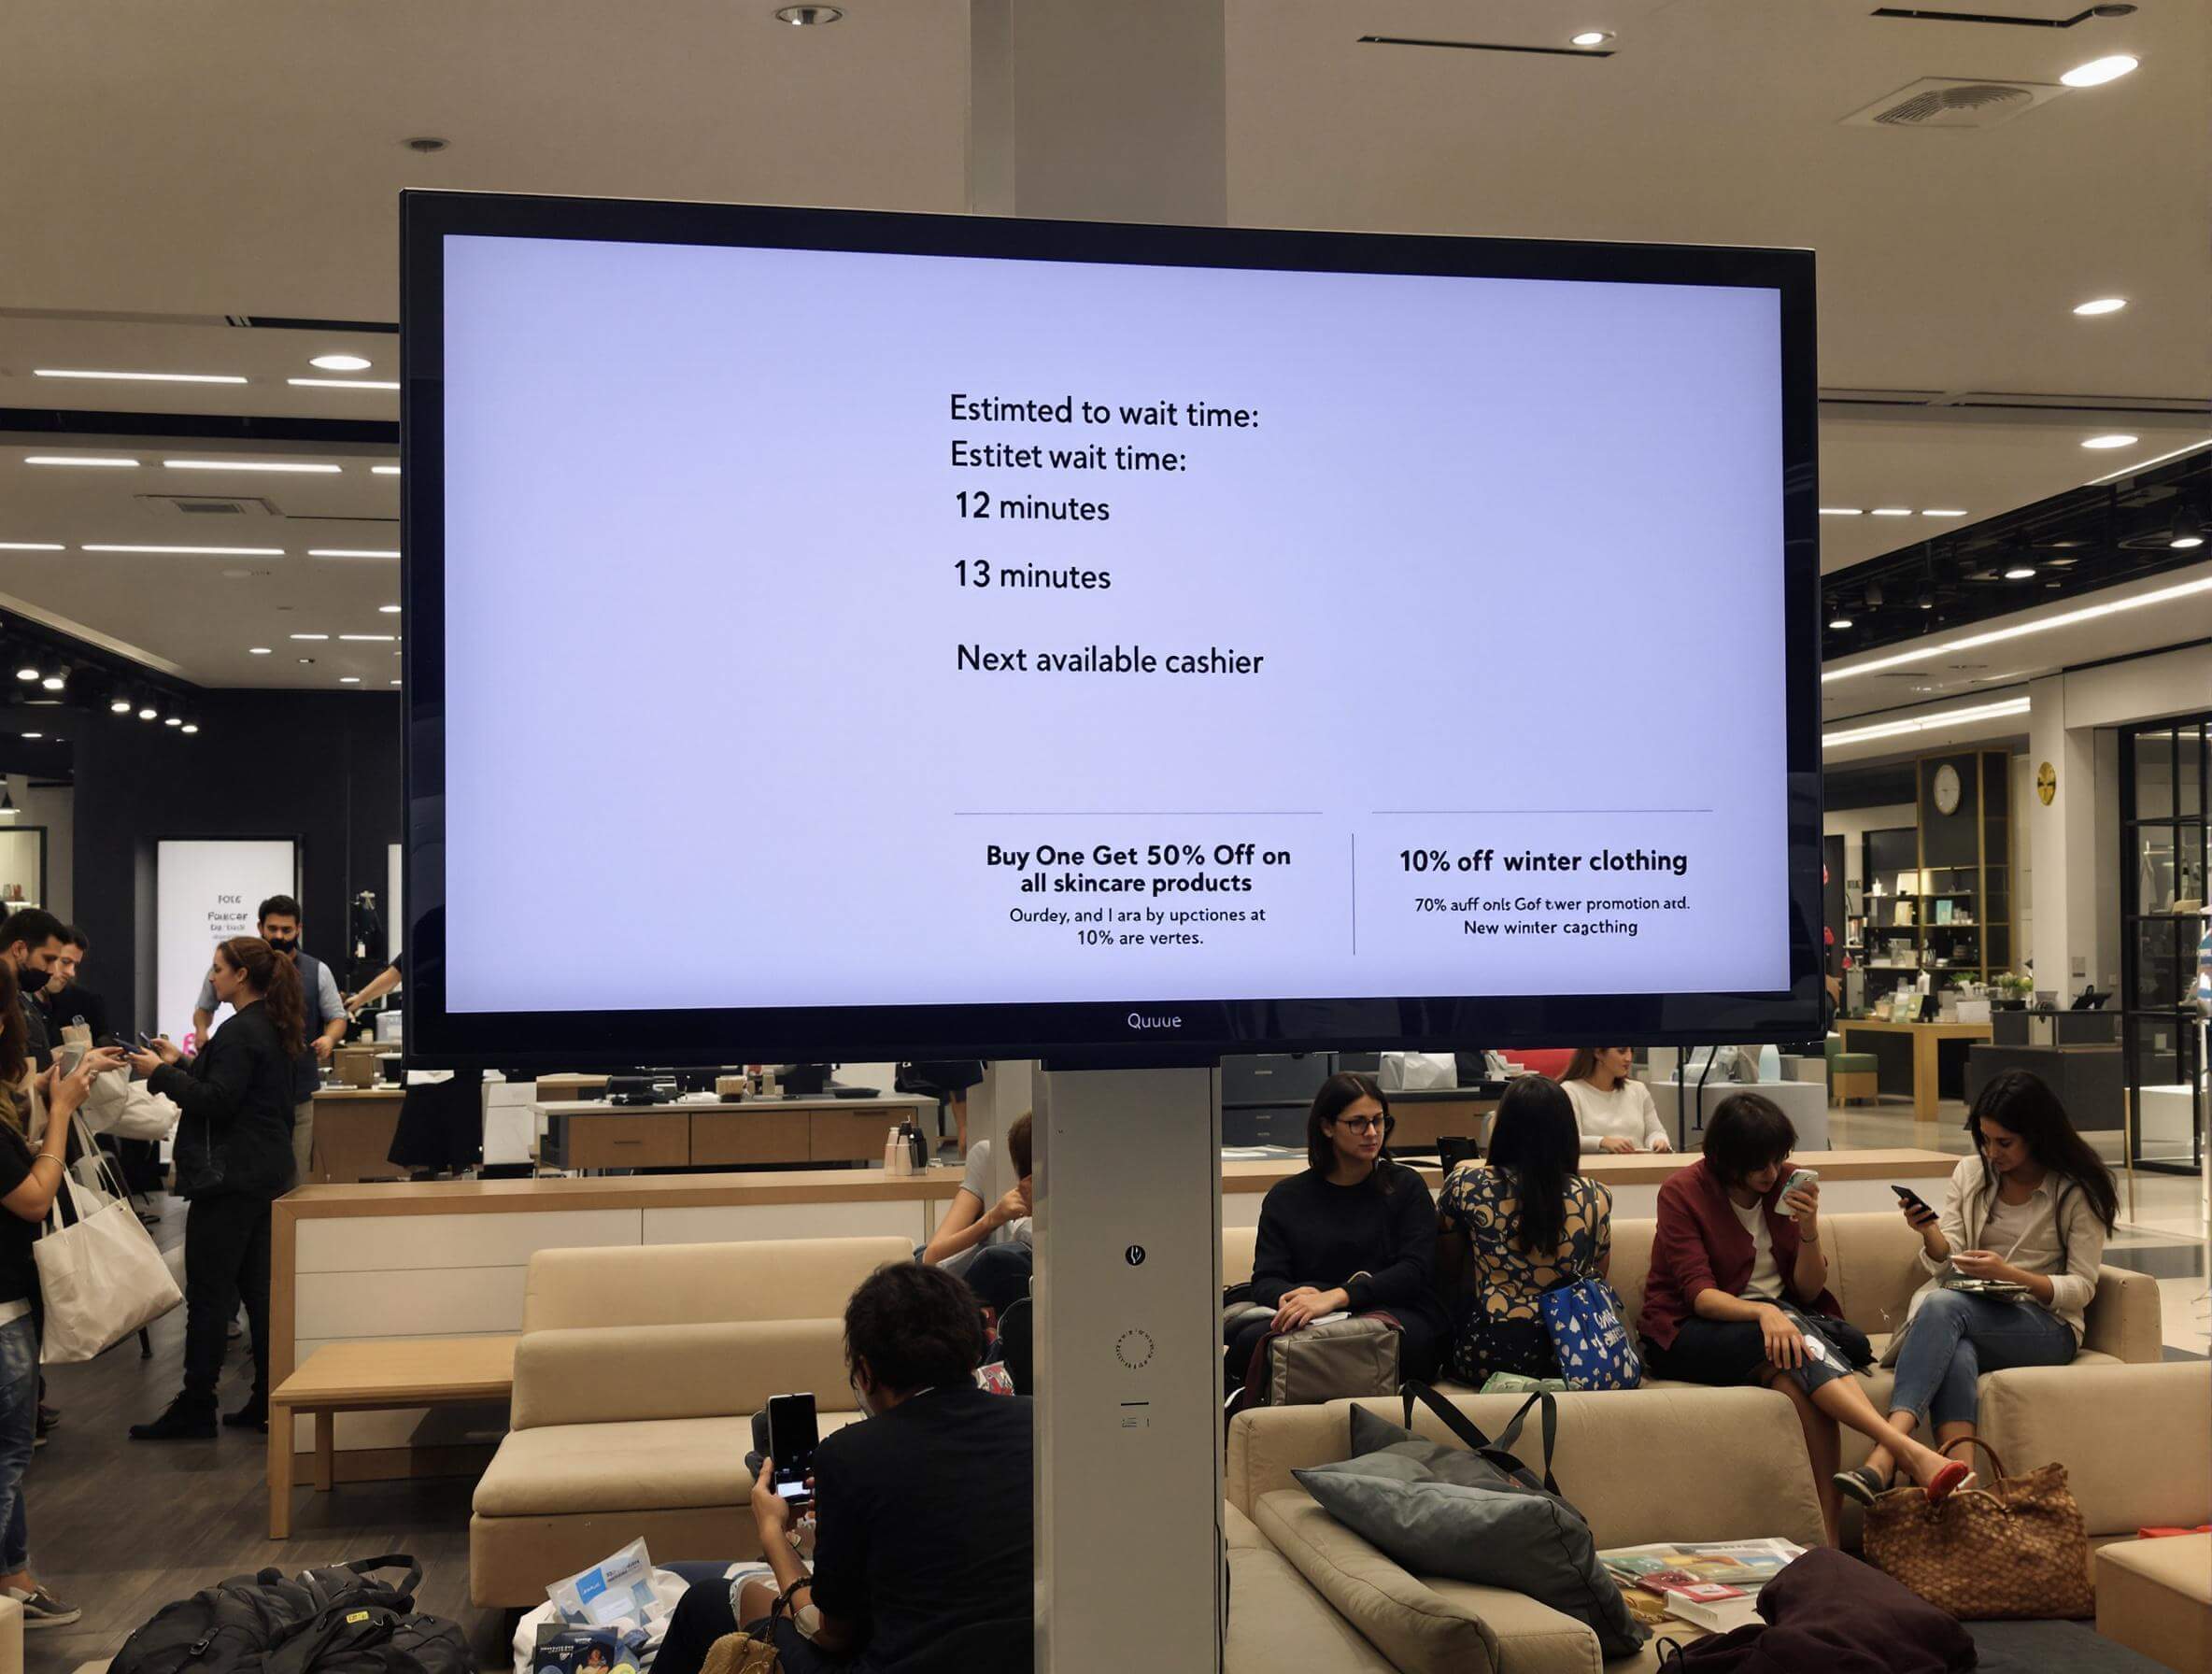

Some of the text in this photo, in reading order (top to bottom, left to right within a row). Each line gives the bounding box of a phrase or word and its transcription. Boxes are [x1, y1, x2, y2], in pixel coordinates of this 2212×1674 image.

[951, 393, 1259, 429] Estimted to wait time:
[951, 440, 1186, 472] Estitet wait time:
[956, 490, 1111, 521] 12 minutes
[954, 559, 1112, 589] 13 minutes
[957, 645, 1265, 674] Next available cashier
[986, 844, 1291, 871] Buy One Get 50% Off on
[1399, 848, 1688, 876] 10% off winter clothing
[1020, 872, 1253, 898] all skincare products
[1009, 907, 1071, 926] Ourdey,
[1074, 906, 1103, 923] and
[1117, 911, 1141, 923] ara
[1145, 906, 1165, 926] by
[1170, 907, 1246, 926] upctiones
[1250, 908, 1267, 922] at
[1414, 897, 1447, 913] 70%
[1450, 896, 1480, 912] auff
[1514, 897, 1542, 912] Gof
[1586, 896, 1660, 915] promotion
[1077, 929, 1204, 945] 10% are vertes.
[1464, 919, 1500, 935] New
[1127, 1013, 1183, 1030] Quuue
